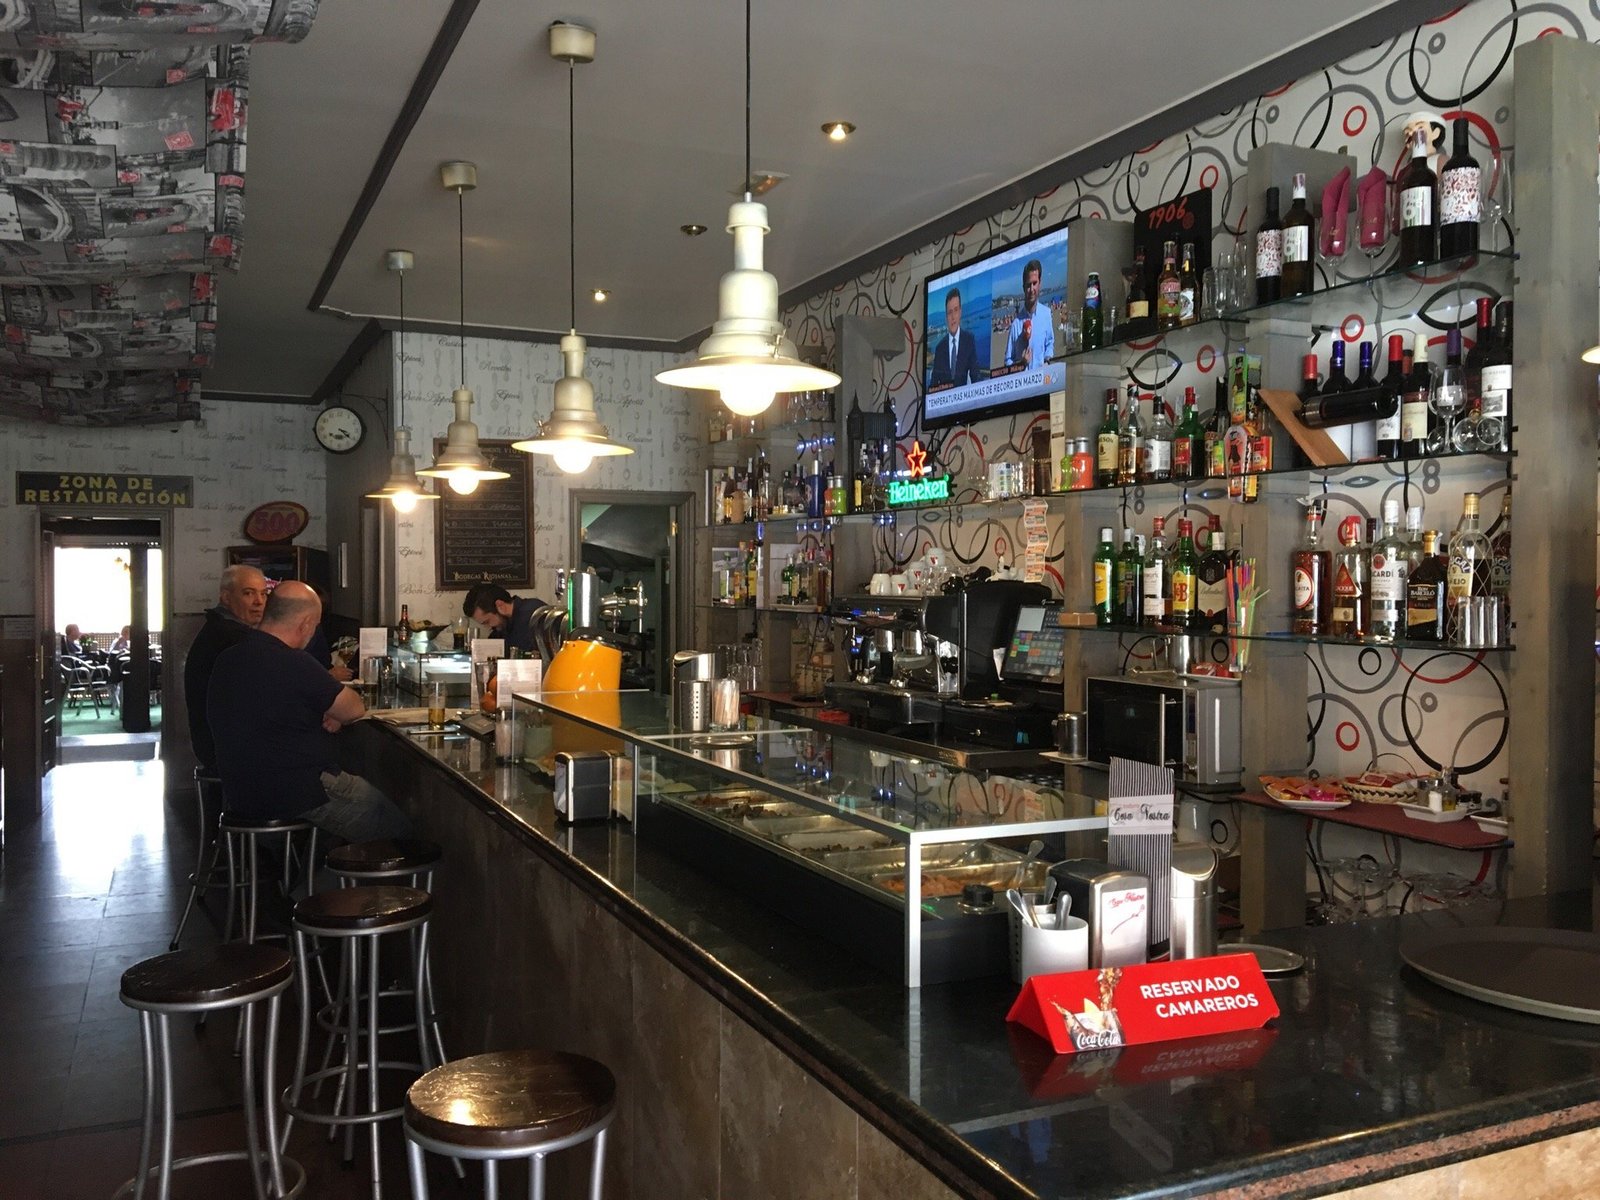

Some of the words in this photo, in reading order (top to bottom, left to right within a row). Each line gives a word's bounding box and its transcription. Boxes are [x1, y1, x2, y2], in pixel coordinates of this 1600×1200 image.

[1148, 197, 1188, 230] 1906
[928, 393, 963, 408] TEMPERATURAS
[985, 385, 993, 396] DE
[993, 380, 1014, 393] RECORD
[1015, 378, 1023, 389] EN
[1023, 373, 1043, 385] MARZO
[59, 476, 118, 490] ZONA
[127, 477, 153, 490] DE
[889, 478, 949, 504] Heineken
[24, 489, 187, 505] RESTAURACIÓN
[254, 511, 300, 534] 500
[1372, 570, 1394, 578] CARDÍ
[1140, 975, 1240, 999] RESERVADO
[1155, 993, 1259, 1018] CAMAREROS
